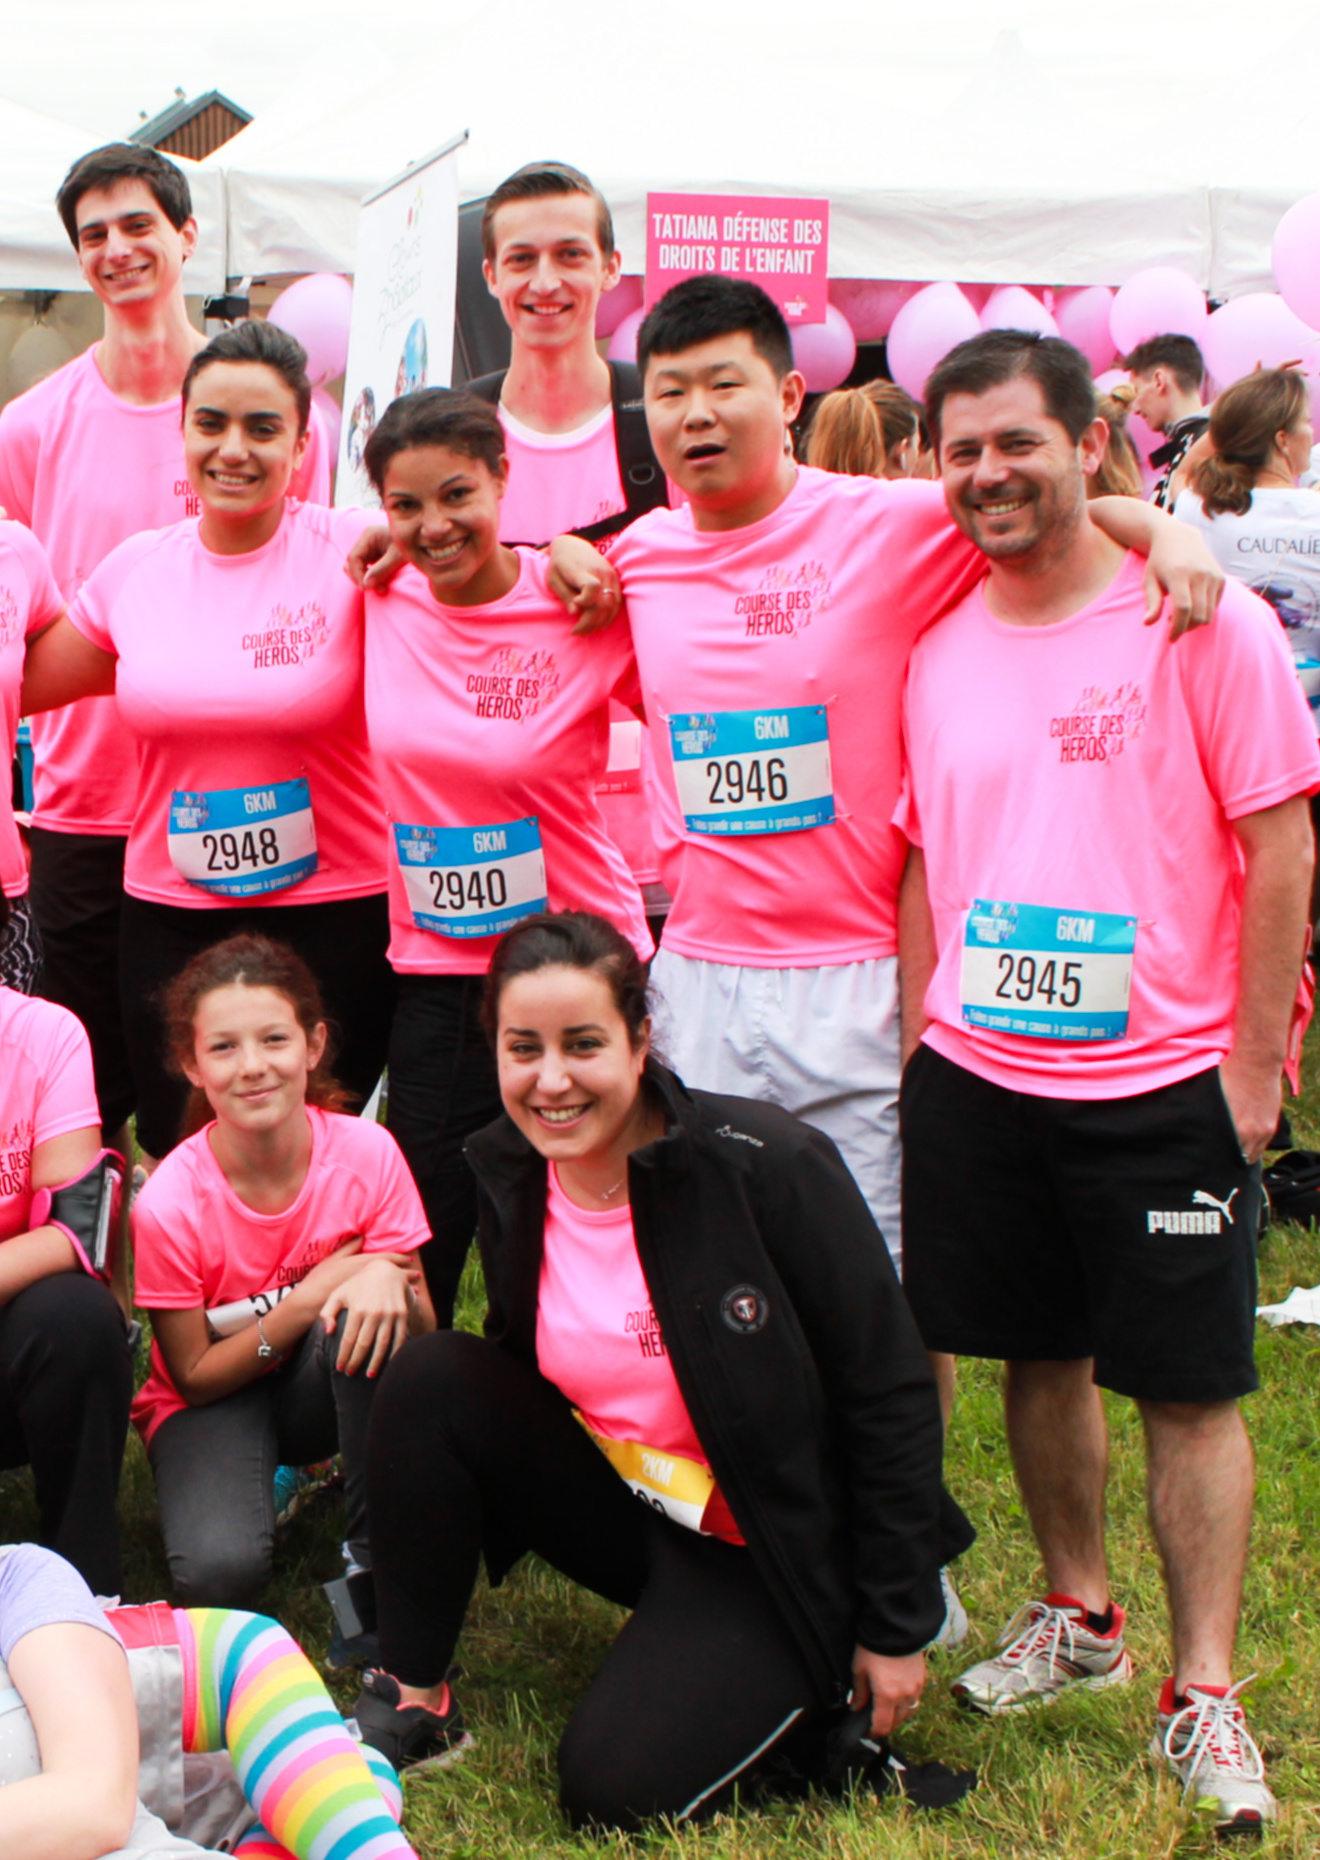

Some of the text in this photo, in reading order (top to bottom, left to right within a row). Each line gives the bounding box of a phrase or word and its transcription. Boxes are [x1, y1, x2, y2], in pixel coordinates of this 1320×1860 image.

[652, 210, 822, 245] TATIANA DÉFENSE DES
[659, 244, 815, 275] DROITS DE L'ENFANT
[734, 590, 811, 615] COURSE DES
[745, 611, 795, 636] HEROS
[241, 626, 312, 650] COURSE DES
[253, 644, 300, 669] HEROS
[466, 674, 540, 698] COURSE DES
[476, 695, 523, 720] HEROS
[754, 714, 789, 740] 6KM
[1050, 714, 1124, 738] COURSE DES
[1060, 735, 1107, 763] HEROS
[706, 757, 788, 804] 2946
[243, 790, 277, 814] 6KM
[202, 827, 280, 871] 2948
[473, 830, 508, 853] 6KM
[429, 868, 508, 910] 2940
[1056, 916, 1096, 944] 6KM
[995, 953, 1082, 1008] 2945
[7, 1150, 31, 1171] DES
[1147, 1210, 1221, 1235] PUMA
[624, 1309, 661, 1332] COUR
[642, 1453, 675, 1487] 2KM
